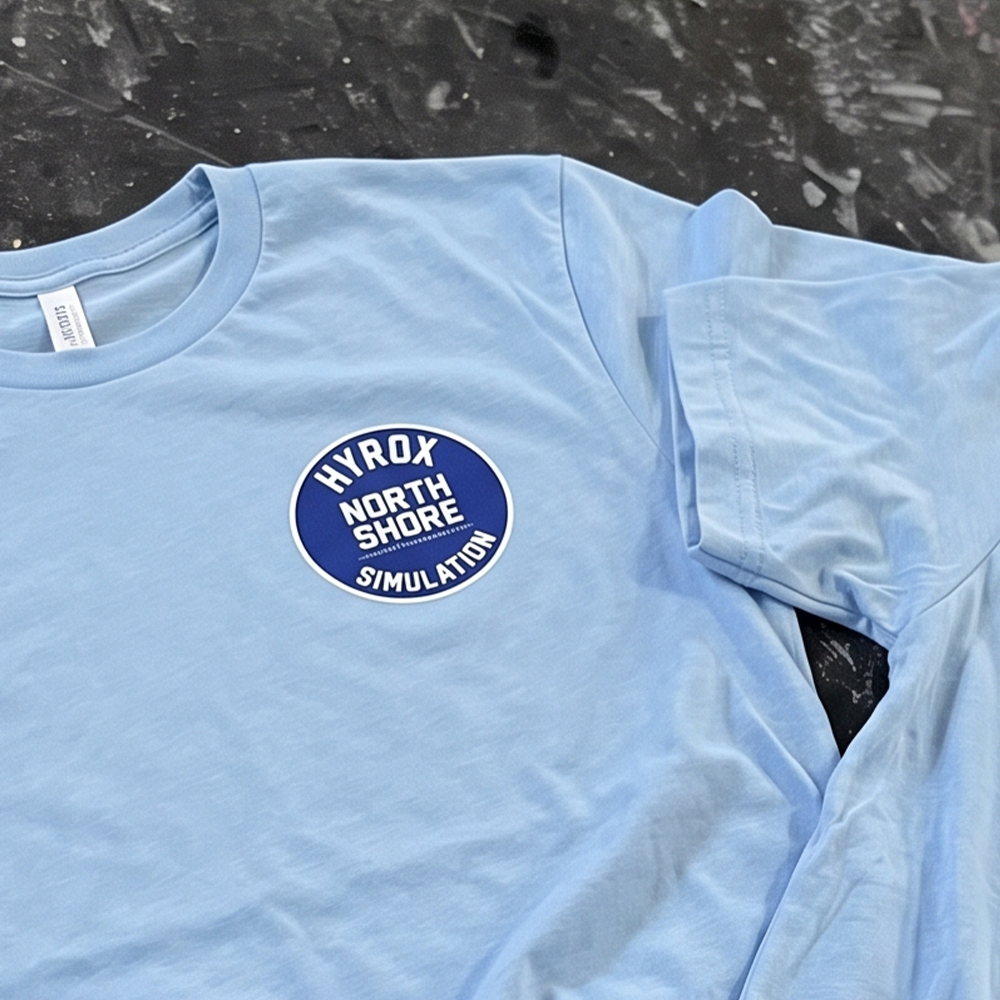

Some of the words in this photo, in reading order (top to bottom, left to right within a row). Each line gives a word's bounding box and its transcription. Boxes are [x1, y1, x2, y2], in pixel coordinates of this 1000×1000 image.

[313, 434, 438, 494] HYROX
[339, 473, 453, 526] NORTH
[353, 498, 465, 550] SHORE
[355, 530, 497, 592] SIMULATION
